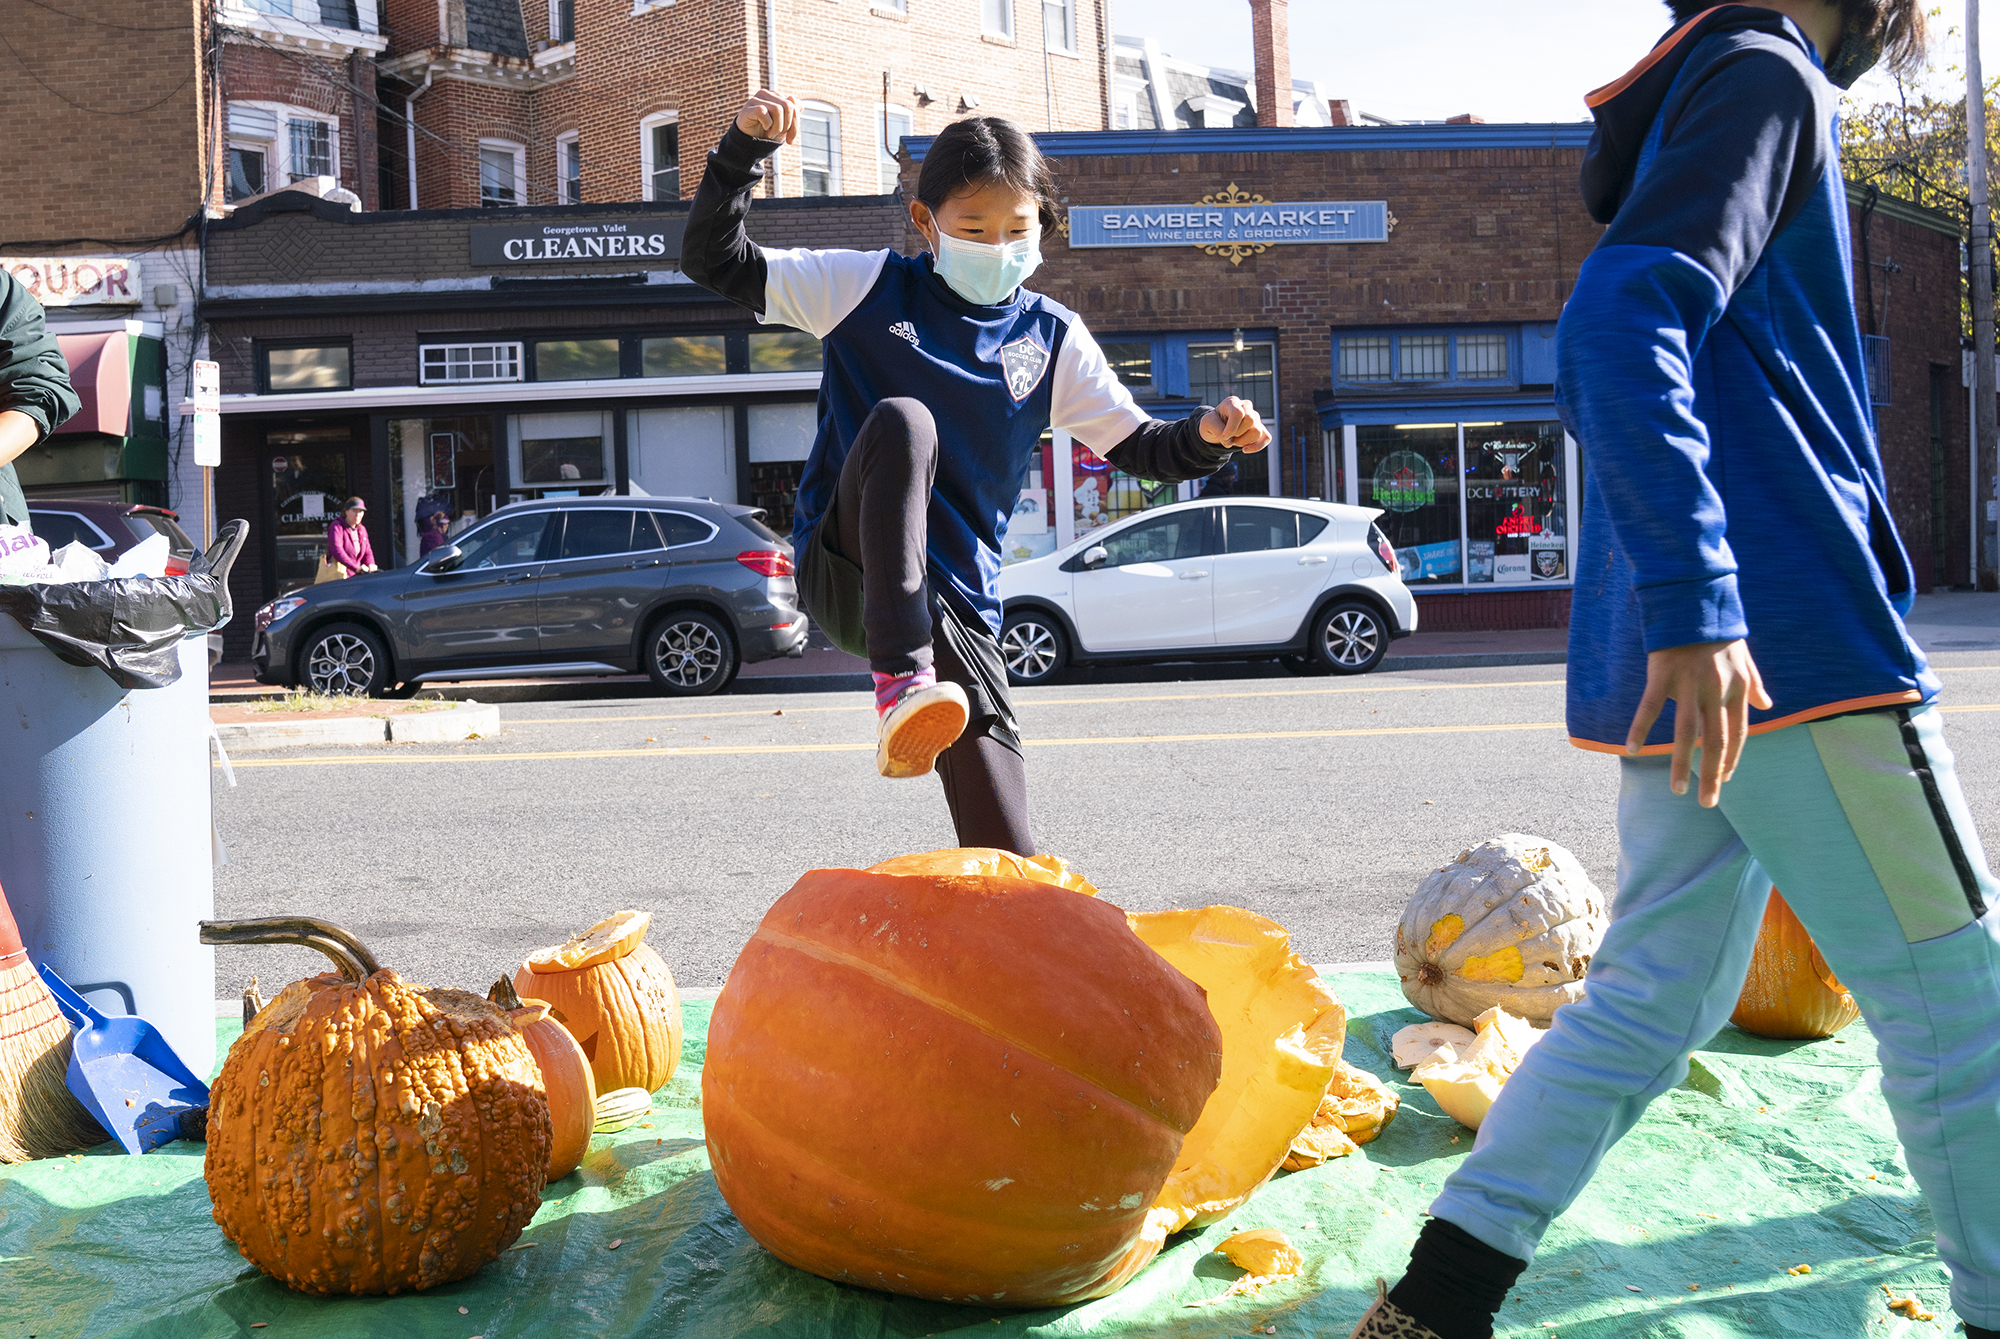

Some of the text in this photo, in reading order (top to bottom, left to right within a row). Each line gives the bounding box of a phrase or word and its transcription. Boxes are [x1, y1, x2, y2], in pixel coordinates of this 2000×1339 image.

[1102, 209, 1356, 230] SAMBER MARKET
[543, 224, 627, 236] Georgetown Valet
[1147, 229, 1311, 240] WINE BEER & GROCERY
[503, 234, 666, 261] CLEANERS
[0, 263, 131, 296] QUOR
[889, 325, 920, 346] adidas
[1019, 344, 1035, 356] DC
[1008, 351, 1042, 364] SOCCER CLUB
[1467, 486, 1540, 499] DC LOTTERY
[1531, 541, 1564, 549] Heineken
[1497, 564, 1526, 574] Corona
